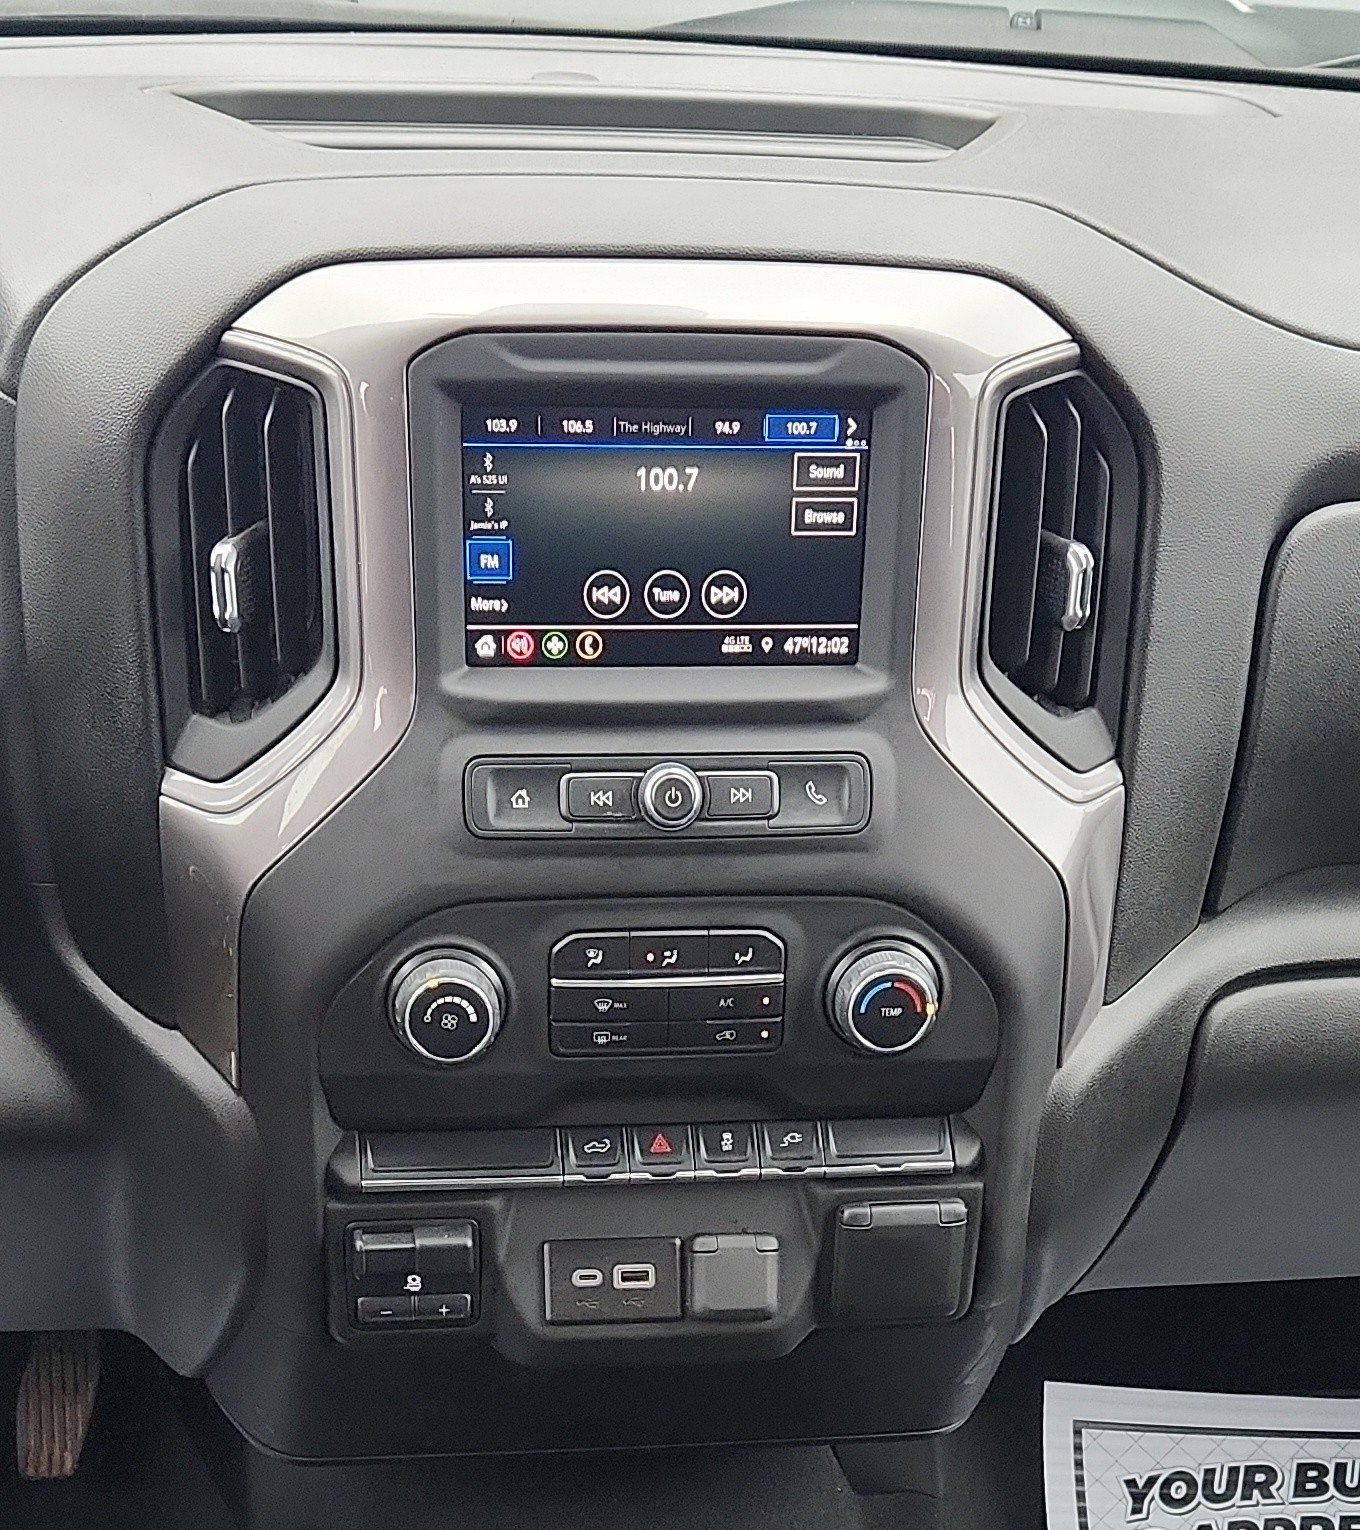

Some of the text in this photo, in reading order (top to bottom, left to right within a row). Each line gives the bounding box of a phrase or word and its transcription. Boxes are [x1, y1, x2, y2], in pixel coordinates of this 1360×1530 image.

[485, 418, 518, 433] 103.9
[562, 420, 594, 434] 106.5
[618, 421, 688, 436] The Highway
[715, 421, 741, 435] 94.9
[787, 422, 818, 435] 100.7
[636, 466, 700, 492] 100.7
[809, 463, 845, 480] Sound
[804, 508, 846, 525] Browse
[479, 554, 500, 570] FM
[652, 587, 681, 603] Tune
[723, 636, 750, 645] 4G LTE
[810, 636, 849, 655] 12:02
[613, 1001, 628, 1009] MAX
[719, 998, 734, 1007] A/C
[880, 1007, 903, 1017] TEMP
[611, 1034, 628, 1042] REAR
[1121, 1463, 1279, 1519] YOUR
